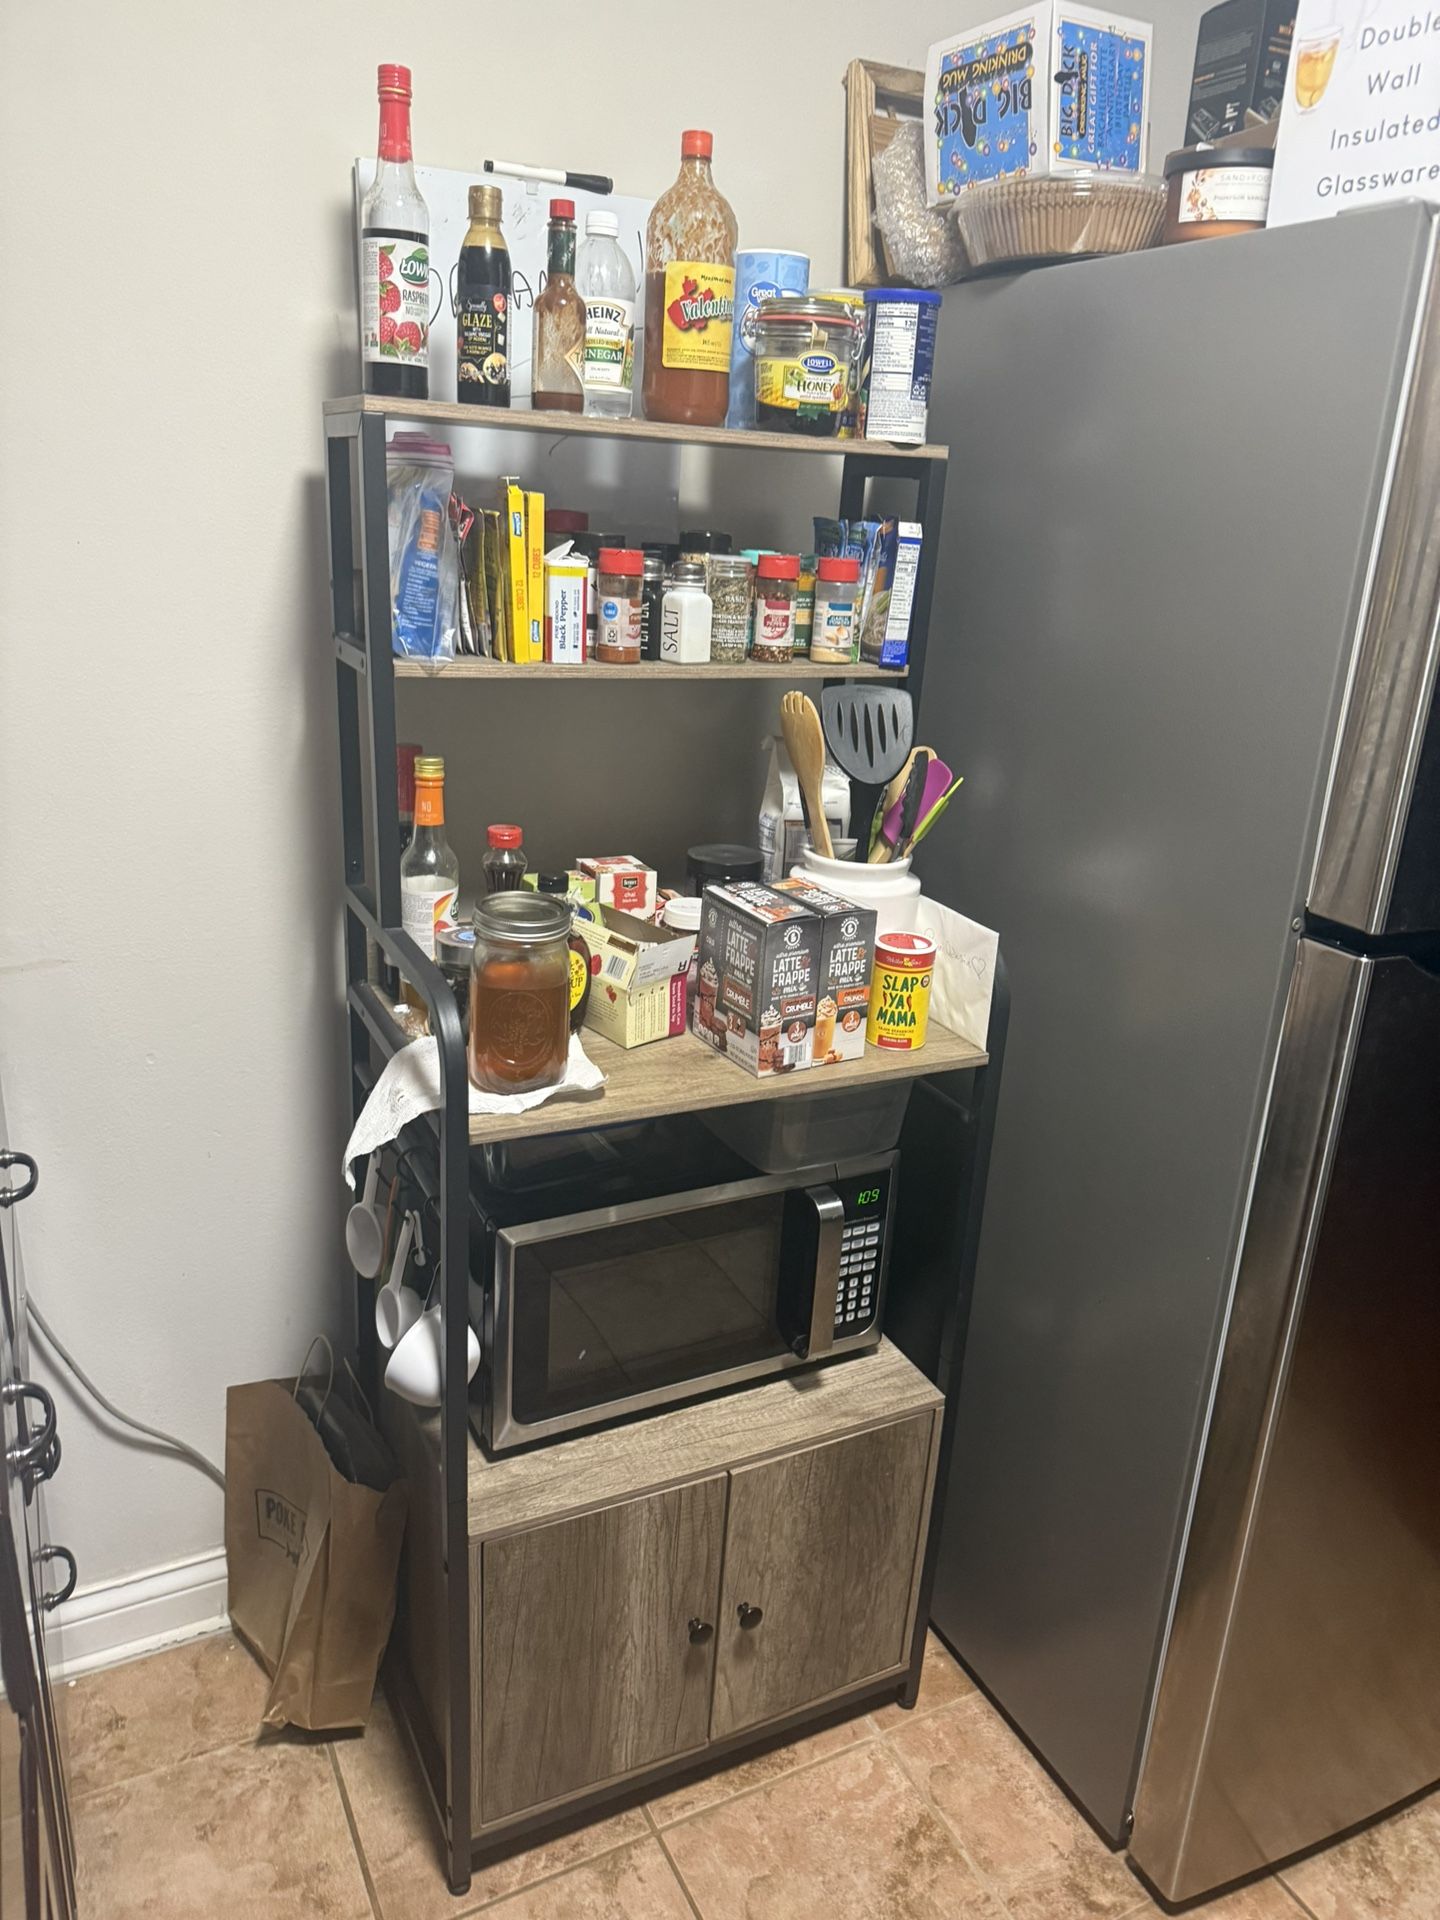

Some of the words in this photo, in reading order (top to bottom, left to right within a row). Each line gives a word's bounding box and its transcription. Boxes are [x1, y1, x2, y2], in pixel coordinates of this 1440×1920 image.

[1360, 11, 1440, 50] Double
[972, 47, 1026, 72] DRINKING
[1090, 42, 1098, 70] FOR
[943, 69, 969, 88] MUG
[1368, 62, 1422, 96] Wall
[998, 78, 1032, 119] BIG
[1061, 106, 1073, 137] BIG
[1088, 109, 1096, 153] GREAT
[1330, 108, 1440, 150] Insulated
[1316, 164, 1440, 197] Glassware
[751, 287, 777, 299] Great
[462, 313, 492, 328] GLAZE
[587, 306, 621, 323] HEINZ
[595, 326, 620, 337] Natural
[797, 380, 835, 393] HONEY
[560, 590, 569, 623] Pepper
[559, 625, 567, 650] Black
[663, 605, 679, 654] SALT
[421, 801, 432, 812] NO
[727, 928, 749, 955] LATTE
[726, 945, 755, 977] FRAPPE
[773, 956, 802, 973] LATTE
[829, 947, 858, 963] LATTE
[771, 968, 811, 987] FRAPPE
[828, 959, 867, 978] FRAPPE
[783, 985, 798, 994] mix
[839, 975, 853, 984] mix
[882, 974, 919, 993] SLAP
[726, 988, 750, 1010] CRUMBLE
[785, 1001, 813, 1013] CRUMBLE
[888, 992, 905, 1009] YA
[876, 1007, 916, 1027] MAMA
[266, 1498, 296, 1536] POKE
